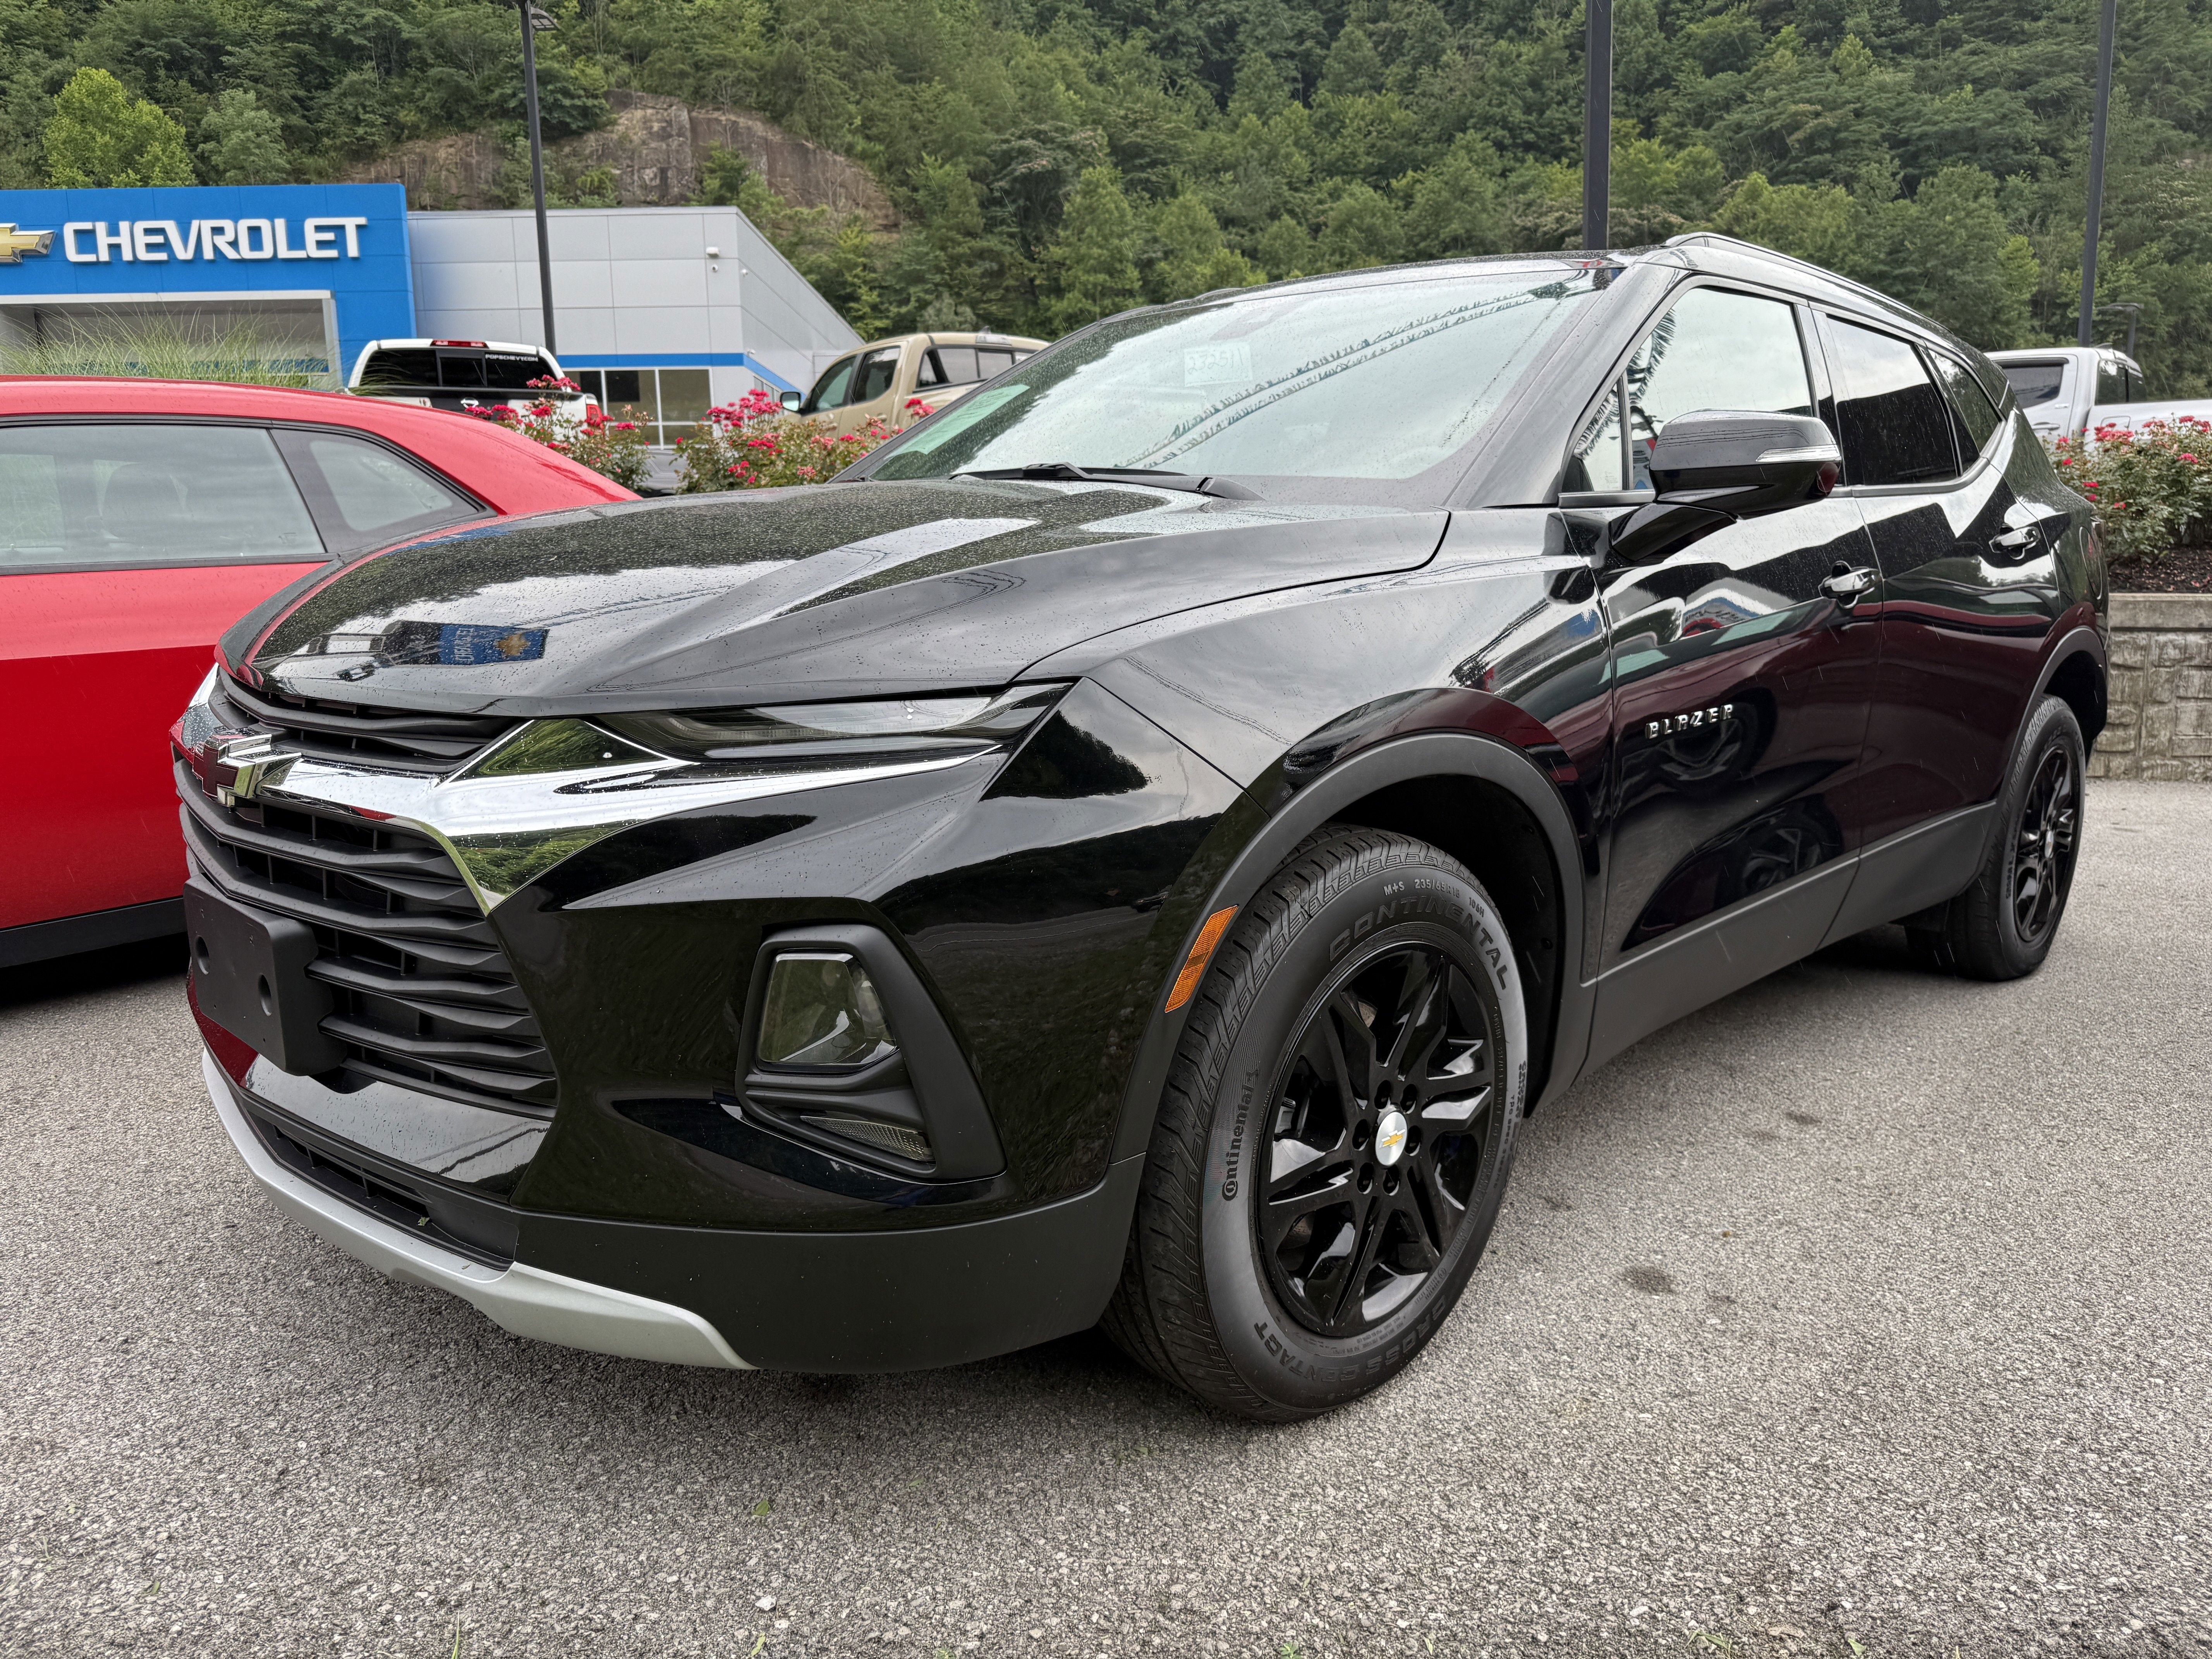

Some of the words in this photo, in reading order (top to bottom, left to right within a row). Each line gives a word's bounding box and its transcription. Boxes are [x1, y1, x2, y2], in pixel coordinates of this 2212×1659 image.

[64, 217, 368, 263] CHEVROLET
[1645, 704, 1734, 739] BLAZER
[1383, 881, 1405, 896] M+S
[1469, 897, 1485, 918] 106H
[1329, 895, 1507, 991] CONTINENTAL
[1221, 1084, 1254, 1202] Continental
